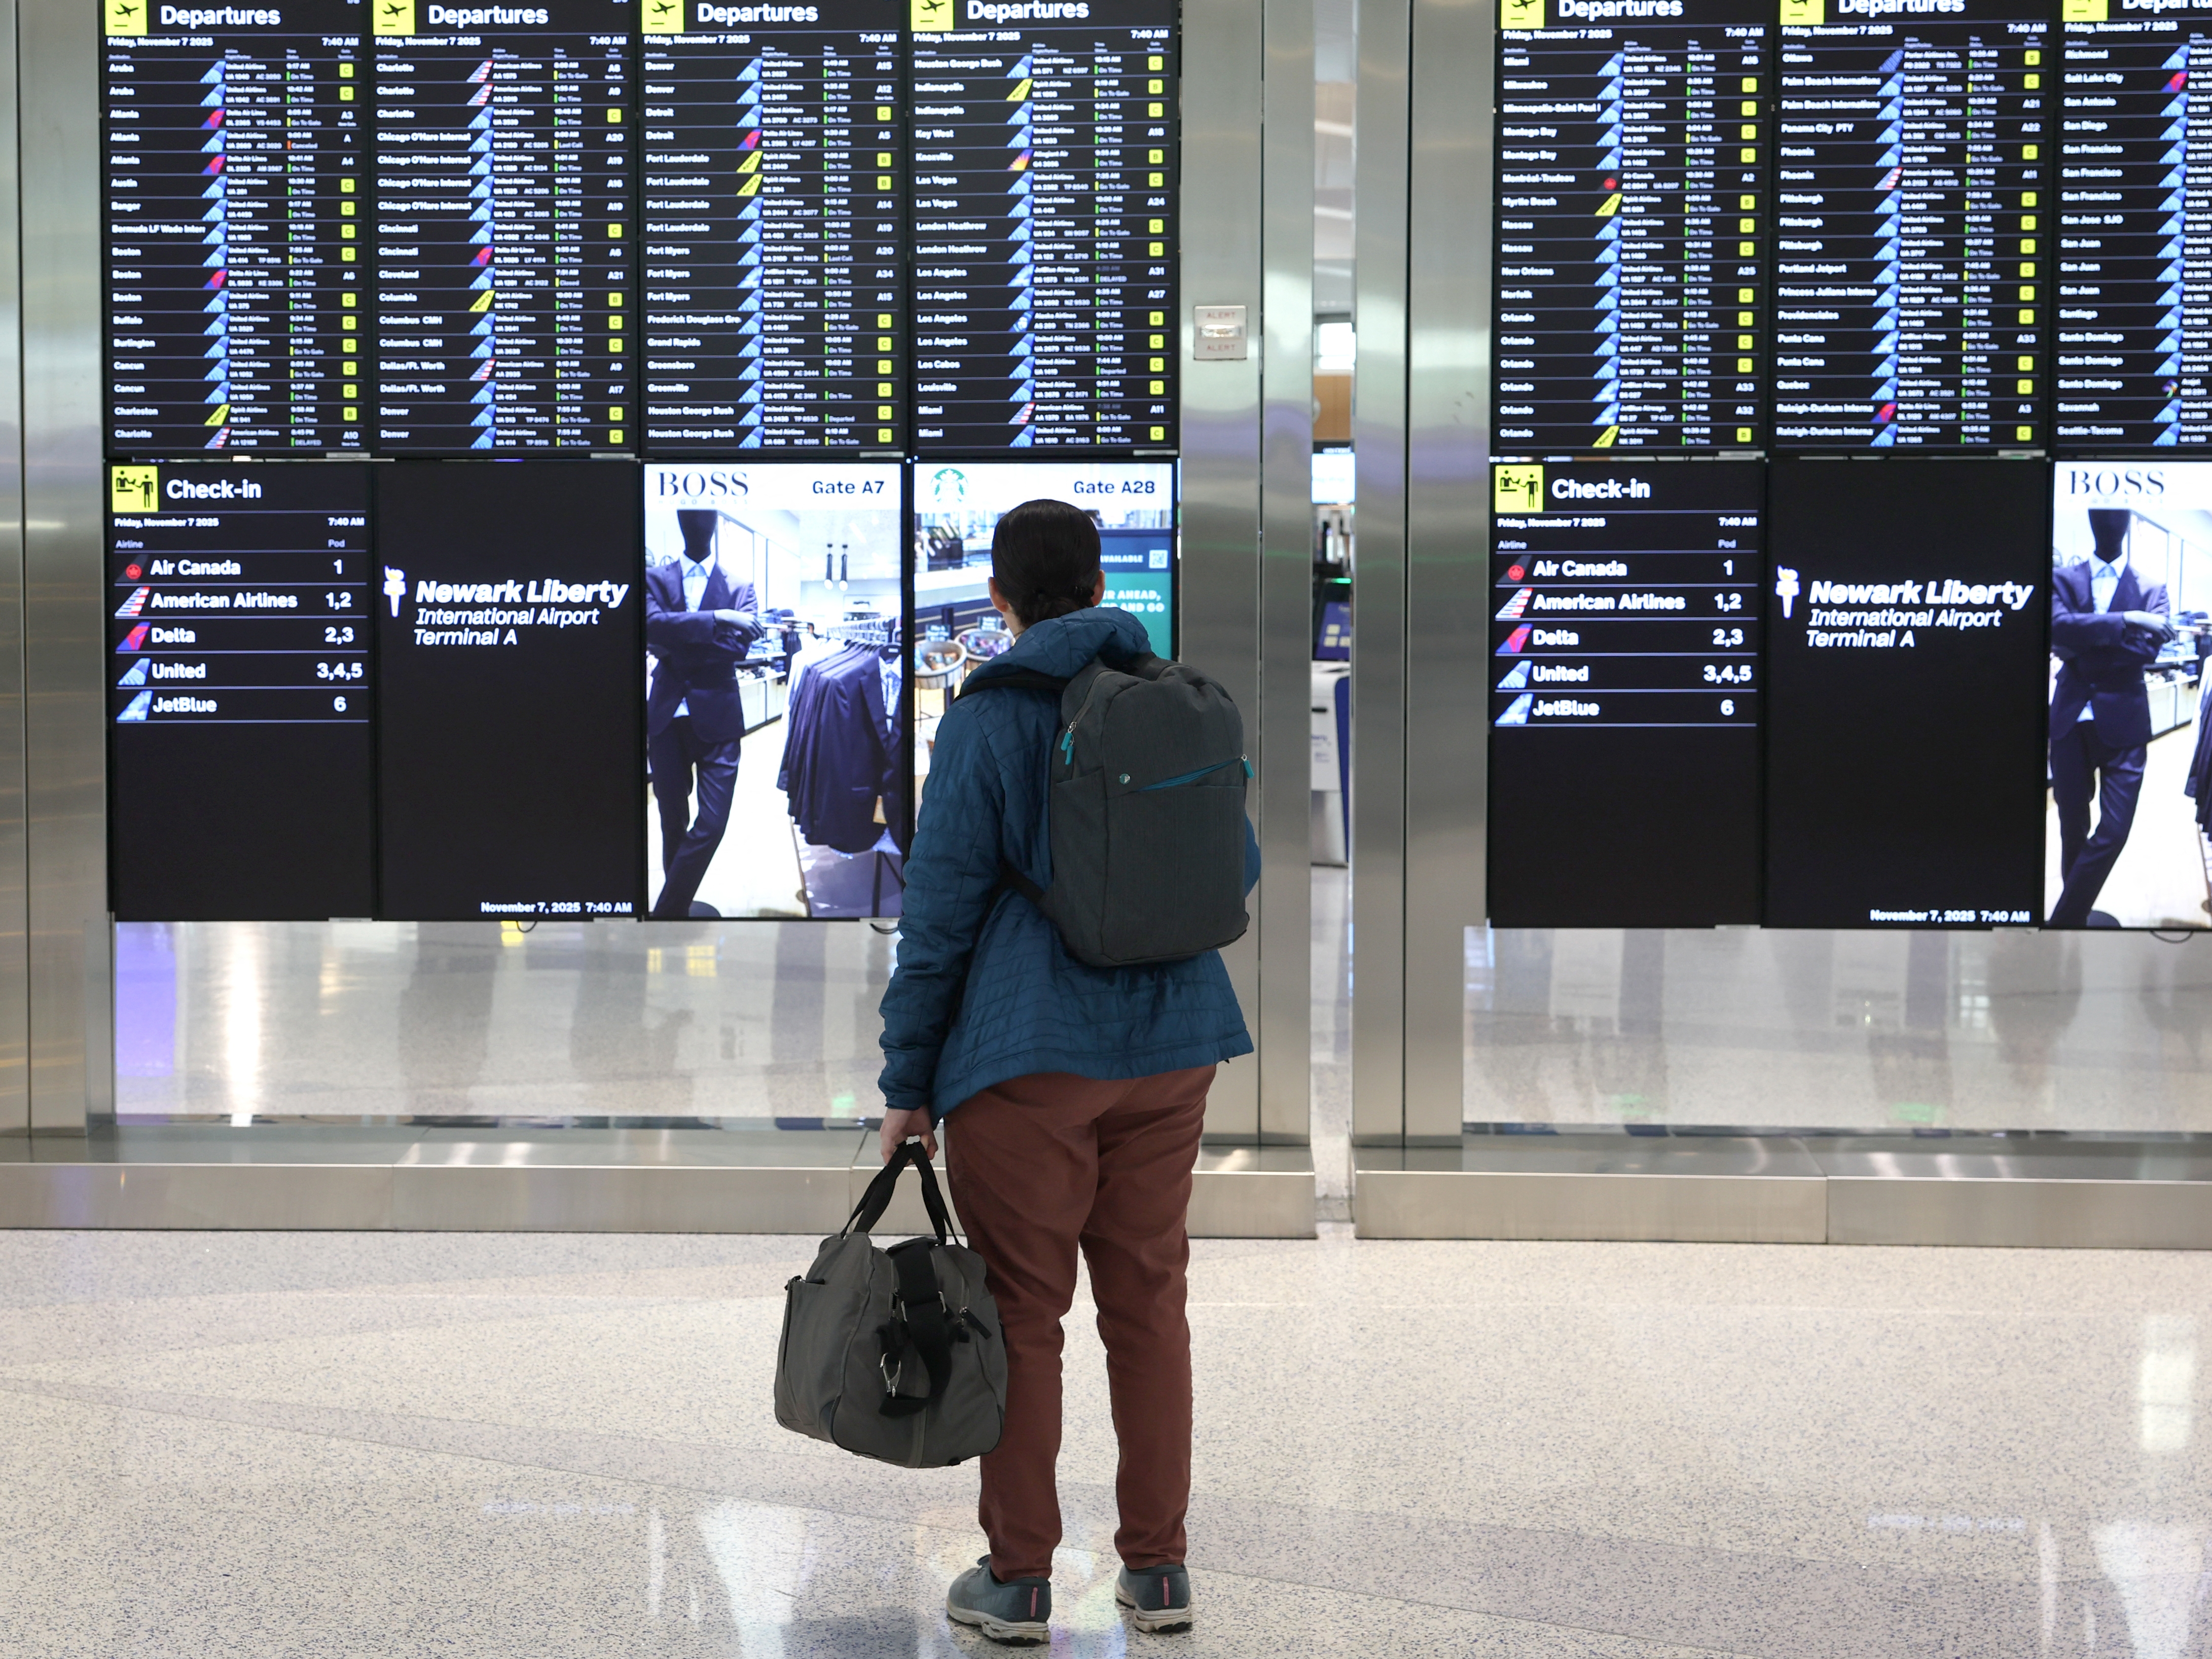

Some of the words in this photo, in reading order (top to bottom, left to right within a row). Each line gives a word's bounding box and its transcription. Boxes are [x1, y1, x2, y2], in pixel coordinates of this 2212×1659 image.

[968, 0, 1089, 23] Departures
[1559, 0, 1683, 21] Departures
[1839, 0, 1965, 17] Departures
[161, 6, 280, 29] Departures
[429, 5, 548, 28] Departures
[698, 3, 818, 26] Departures
[107, 37, 136, 48] Friday,
[137, 38, 180, 46] November
[182, 38, 188, 46] 7
[190, 38, 213, 46] 2025
[322, 38, 343, 46] 7:40
[344, 38, 358, 46] AM
[1783, 53, 1812, 62] Ottawa
[2065, 50, 2108, 59] Richmond
[109, 64, 134, 72] Aruba
[377, 63, 414, 71] Charlotte
[915, 83, 964, 93] Indianapolis
[2064, 97, 2081, 106] San
[2081, 97, 2116, 106] Antonio
[110, 110, 139, 118] Atlanta
[341, 111, 353, 119] A3
[646, 108, 674, 117] Detroit
[1782, 124, 1815, 132] Panama
[1815, 124, 1833, 134] City
[1836, 123, 1854, 132] PTY
[377, 132, 411, 142] Chicago
[411, 133, 438, 141] O'Hare
[438, 133, 471, 141] Internat
[606, 133, 624, 141] A20
[664, 154, 709, 162] Lauderdale
[916, 153, 953, 161] Knoxville
[111, 179, 137, 187] Austin
[112, 202, 141, 211] Bangor
[378, 225, 418, 233] Cincinnati
[112, 247, 141, 256] Boston
[647, 246, 664, 255] Fort
[665, 246, 690, 256] Myers
[917, 245, 947, 254] London
[948, 245, 987, 253] Heathrow
[1502, 244, 1533, 252] Nassau
[379, 270, 419, 278] Cleveland
[608, 271, 623, 279] A21
[1502, 267, 1520, 275] New
[1520, 267, 1554, 275] Orleans
[1737, 267, 1756, 275] A25
[1148, 290, 1165, 298] A27
[2060, 286, 2078, 295] San
[2078, 286, 2099, 295] Juan
[917, 292, 932, 300] Los
[933, 291, 967, 301] Angeles
[113, 316, 142, 324] Buffalo
[422, 316, 442, 324] CMH
[1501, 313, 1535, 322] Orlando
[114, 339, 155, 348] Burlington
[647, 338, 672, 346] Grand
[673, 338, 701, 348] Rapids
[1778, 334, 1802, 343] Punta
[1802, 334, 1825, 343] Cana
[114, 362, 144, 370] Cancun
[648, 361, 695, 369] Greensboro
[380, 384, 420, 392] Dallas/Ft.
[1777, 381, 1809, 389] Quebec
[115, 407, 158, 415] Charleston
[660, 473, 748, 495] BOSS
[813, 481, 855, 493] Gate
[862, 481, 884, 493] A7
[1074, 481, 1114, 493] Gate
[1122, 481, 1154, 493] A28
[2072, 471, 2164, 494] BOSS
[167, 479, 261, 498] Check-in
[1552, 478, 1650, 498] Check-in
[115, 518, 143, 528] Friday,
[144, 518, 187, 526] November
[188, 518, 194, 526] 7
[196, 518, 219, 526] 2025
[328, 518, 349, 526] 7:40
[1498, 518, 1527, 529] Friday,
[1528, 518, 1572, 527] November
[1573, 518, 1580, 527] 7
[1581, 518, 1606, 527] 2025
[1719, 517, 1740, 526] 7:40
[1742, 517, 1757, 526] AM
[116, 540, 143, 548] Airline
[1498, 540, 1527, 549] Airline
[1718, 539, 1736, 548] Pod
[151, 560, 175, 575] Air
[178, 560, 240, 575] Canada
[334, 559, 342, 574] 1
[1533, 560, 1559, 576] Air
[1562, 560, 1627, 576] Canada
[1724, 560, 1732, 575] 1
[416, 580, 524, 603] Newark
[527, 579, 629, 608] Liberty
[1117, 590, 1162, 601] AHEAD,
[1809, 581, 1925, 604] Newark
[1925, 579, 2034, 610] Liberty
[151, 593, 230, 608] American
[233, 592, 298, 607] Airlines
[326, 592, 351, 610] 1,2
[1533, 594, 1615, 609] American
[1618, 593, 1685, 609] Airlines
[1715, 593, 1741, 611] 1,2
[1120, 602, 1145, 612] AND
[1146, 602, 1165, 612] GO
[416, 607, 534, 625] International
[537, 607, 600, 628] Airport
[1808, 609, 1935, 627] International
[1935, 609, 2002, 631] Airport
[152, 628, 195, 642] Delta
[325, 627, 353, 644] 2,3
[414, 628, 499, 645] Terminal
[503, 629, 517, 644] A
[1533, 630, 1578, 645] Delta
[1713, 629, 1743, 647] 2,3
[1806, 629, 1896, 647] Terminal
[1900, 630, 1914, 647] A
[152, 663, 205, 678] United
[317, 663, 362, 680] 3,4,5
[1533, 665, 1588, 681] United
[1704, 665, 1752, 683] 3,4,5
[153, 697, 217, 712] JetBlue
[334, 697, 346, 711] 6
[1533, 700, 1600, 716] JetBlue
[1721, 700, 1734, 715] 6
[481, 902, 536, 912] November
[537, 902, 549, 914] 7,
[552, 902, 581, 912] 2025
[586, 902, 612, 912] 7:40
[614, 903, 632, 912] AM
[1870, 910, 1928, 921] November
[1930, 910, 1942, 923] 7,
[1944, 910, 1976, 921] 2025
[1980, 911, 2009, 922] 7:40
[2010, 911, 2029, 922] AM
